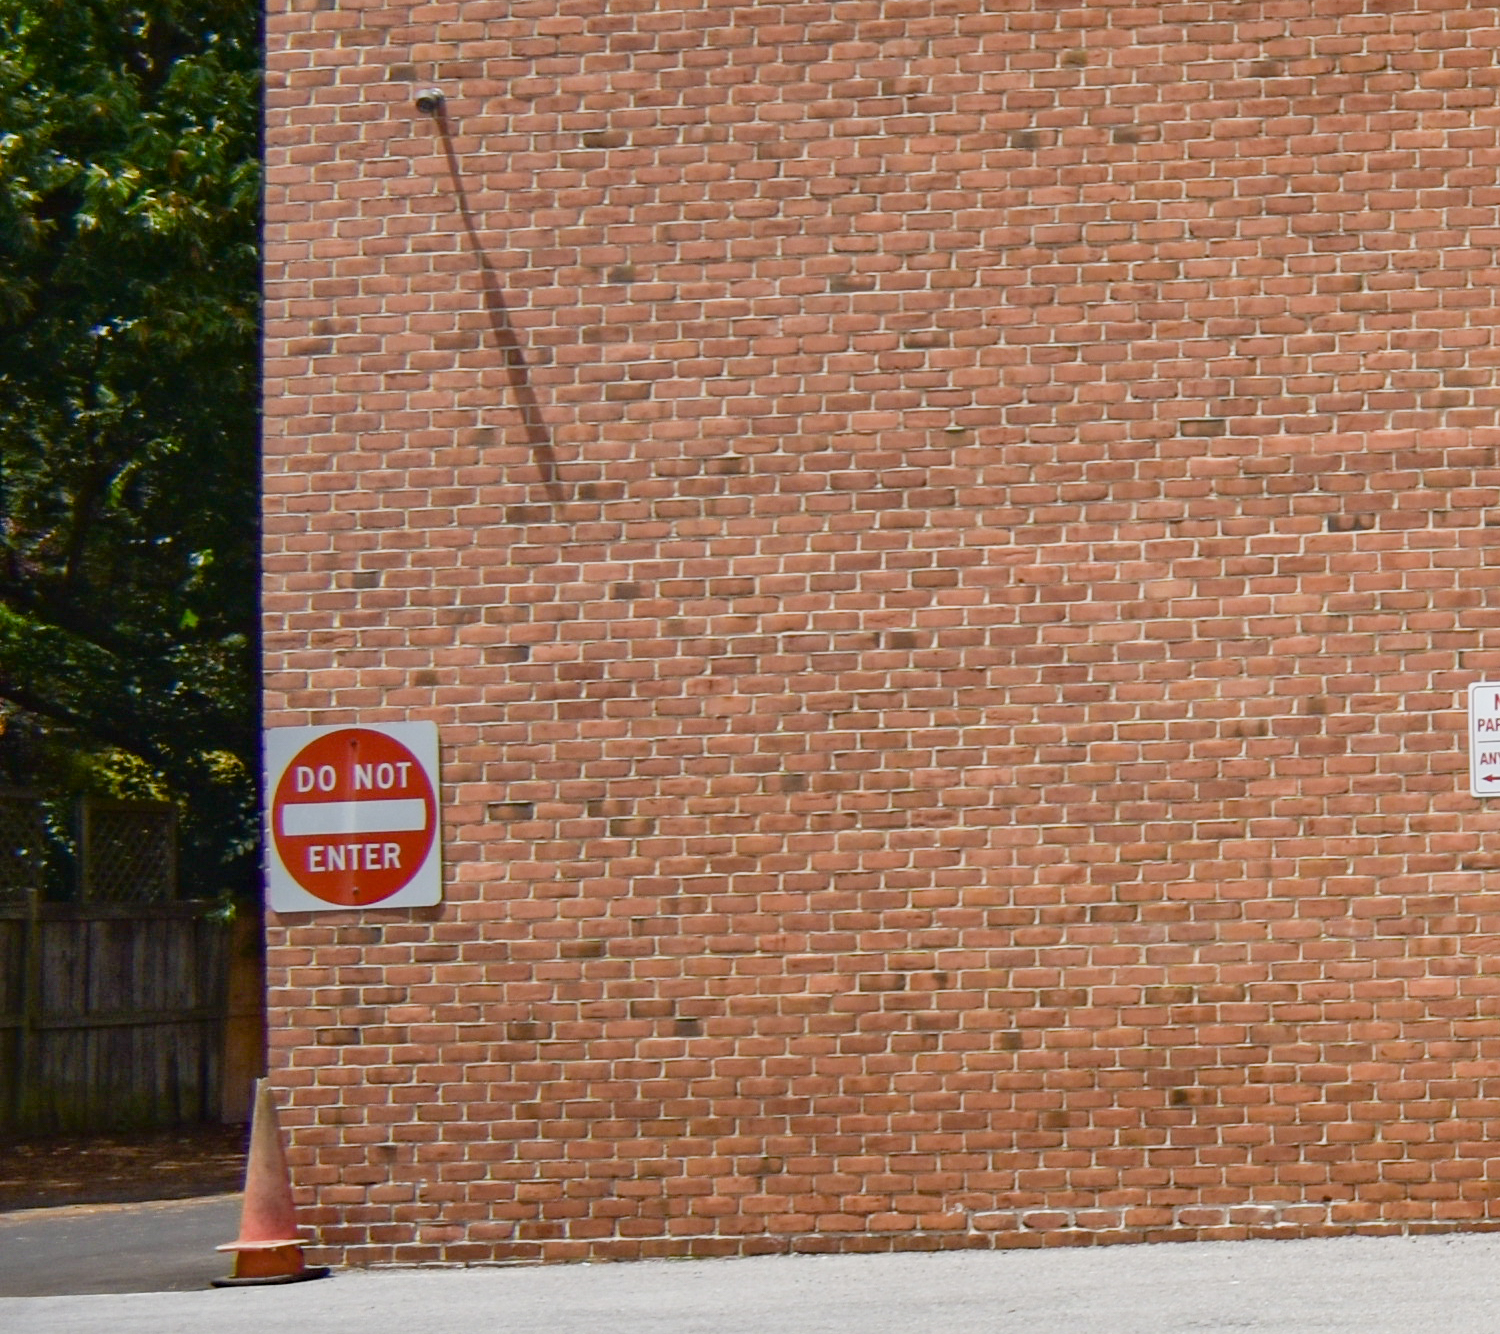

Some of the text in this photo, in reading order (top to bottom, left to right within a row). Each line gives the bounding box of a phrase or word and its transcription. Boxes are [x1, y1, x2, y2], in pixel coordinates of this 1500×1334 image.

[297, 762, 412, 793] DO NOT
[309, 843, 402, 872] ENTER
